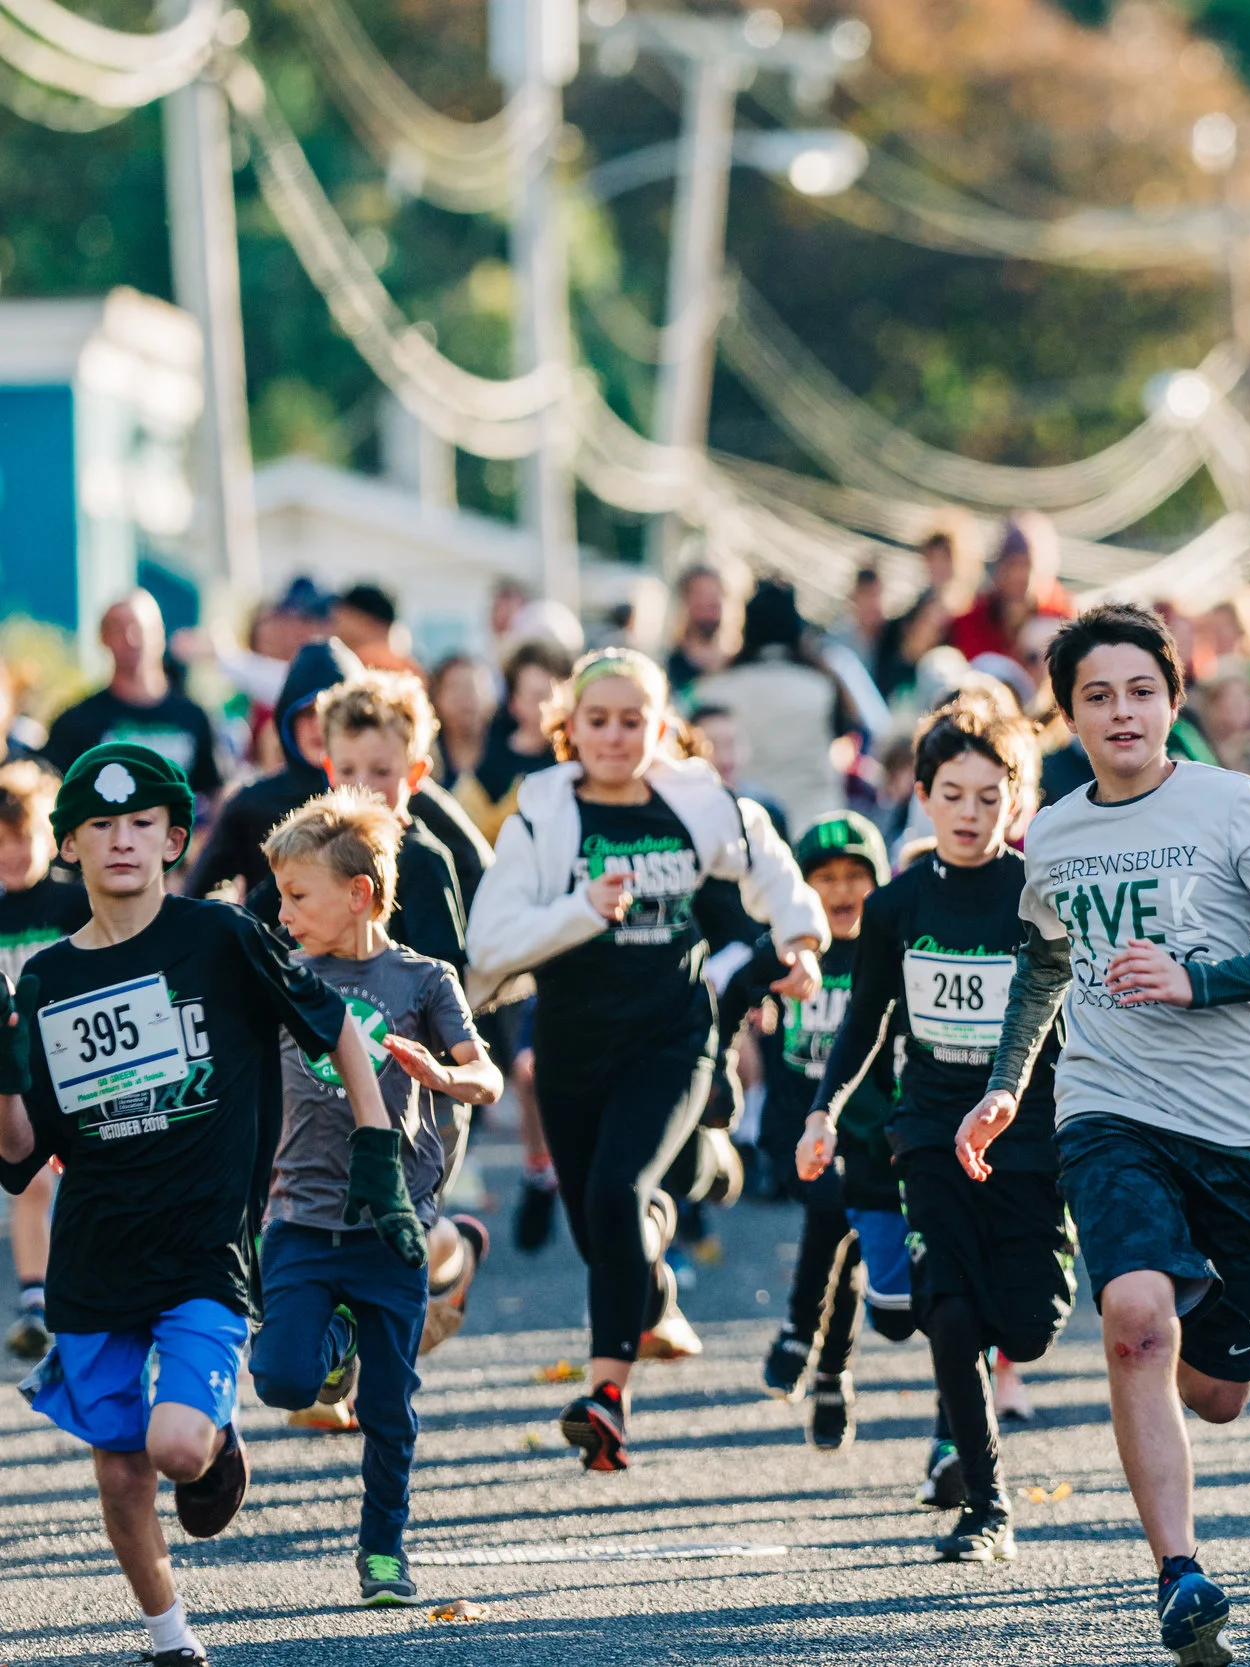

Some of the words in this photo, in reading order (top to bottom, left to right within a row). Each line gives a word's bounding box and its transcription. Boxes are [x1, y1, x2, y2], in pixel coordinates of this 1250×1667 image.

[1049, 846, 1198, 887] SHREWSBURY
[934, 972, 984, 1011] 248
[73, 1003, 139, 1063] 395
[98, 1119, 142, 1141] OCTOBER
[141, 1114, 169, 1133] 2018
